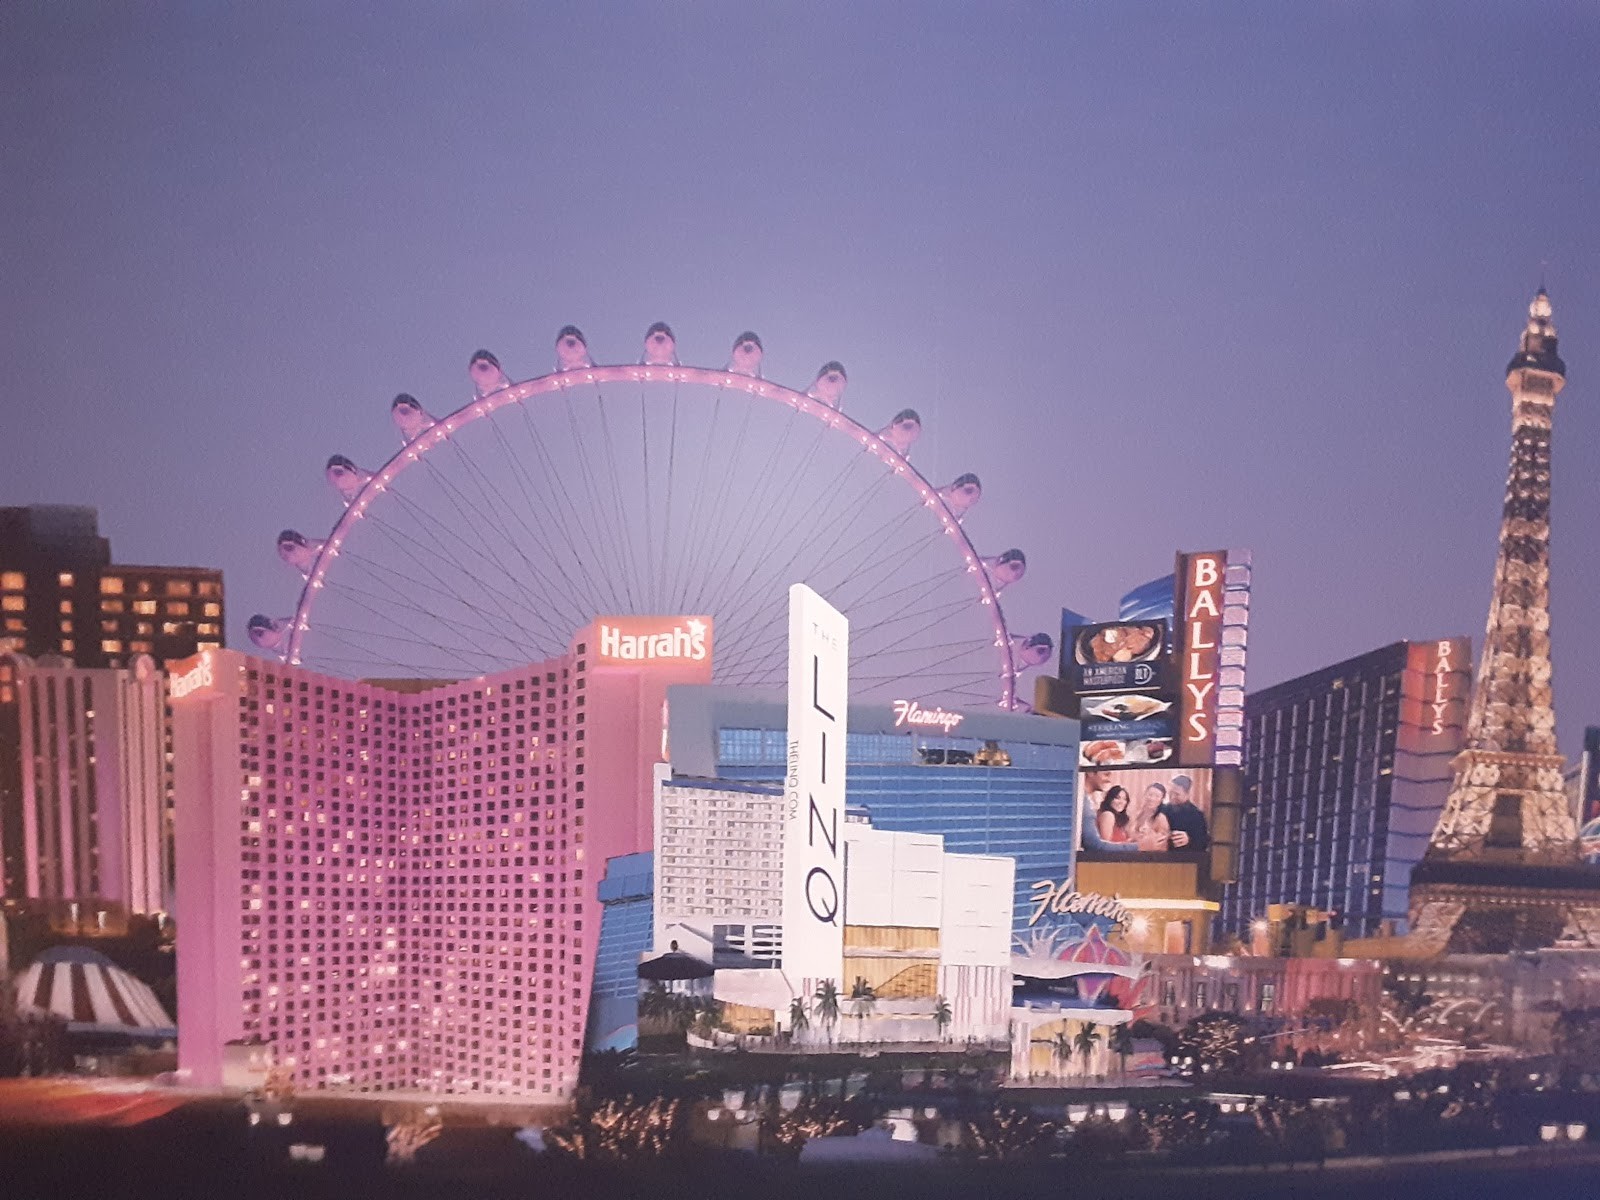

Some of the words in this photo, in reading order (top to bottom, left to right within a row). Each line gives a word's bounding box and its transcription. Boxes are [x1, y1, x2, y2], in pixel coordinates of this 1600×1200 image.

[812, 621, 839, 652] THE
[1187, 558, 1218, 742] BALLYS
[893, 699, 963, 732] Flamingo
[805, 653, 838, 928] LINQ
